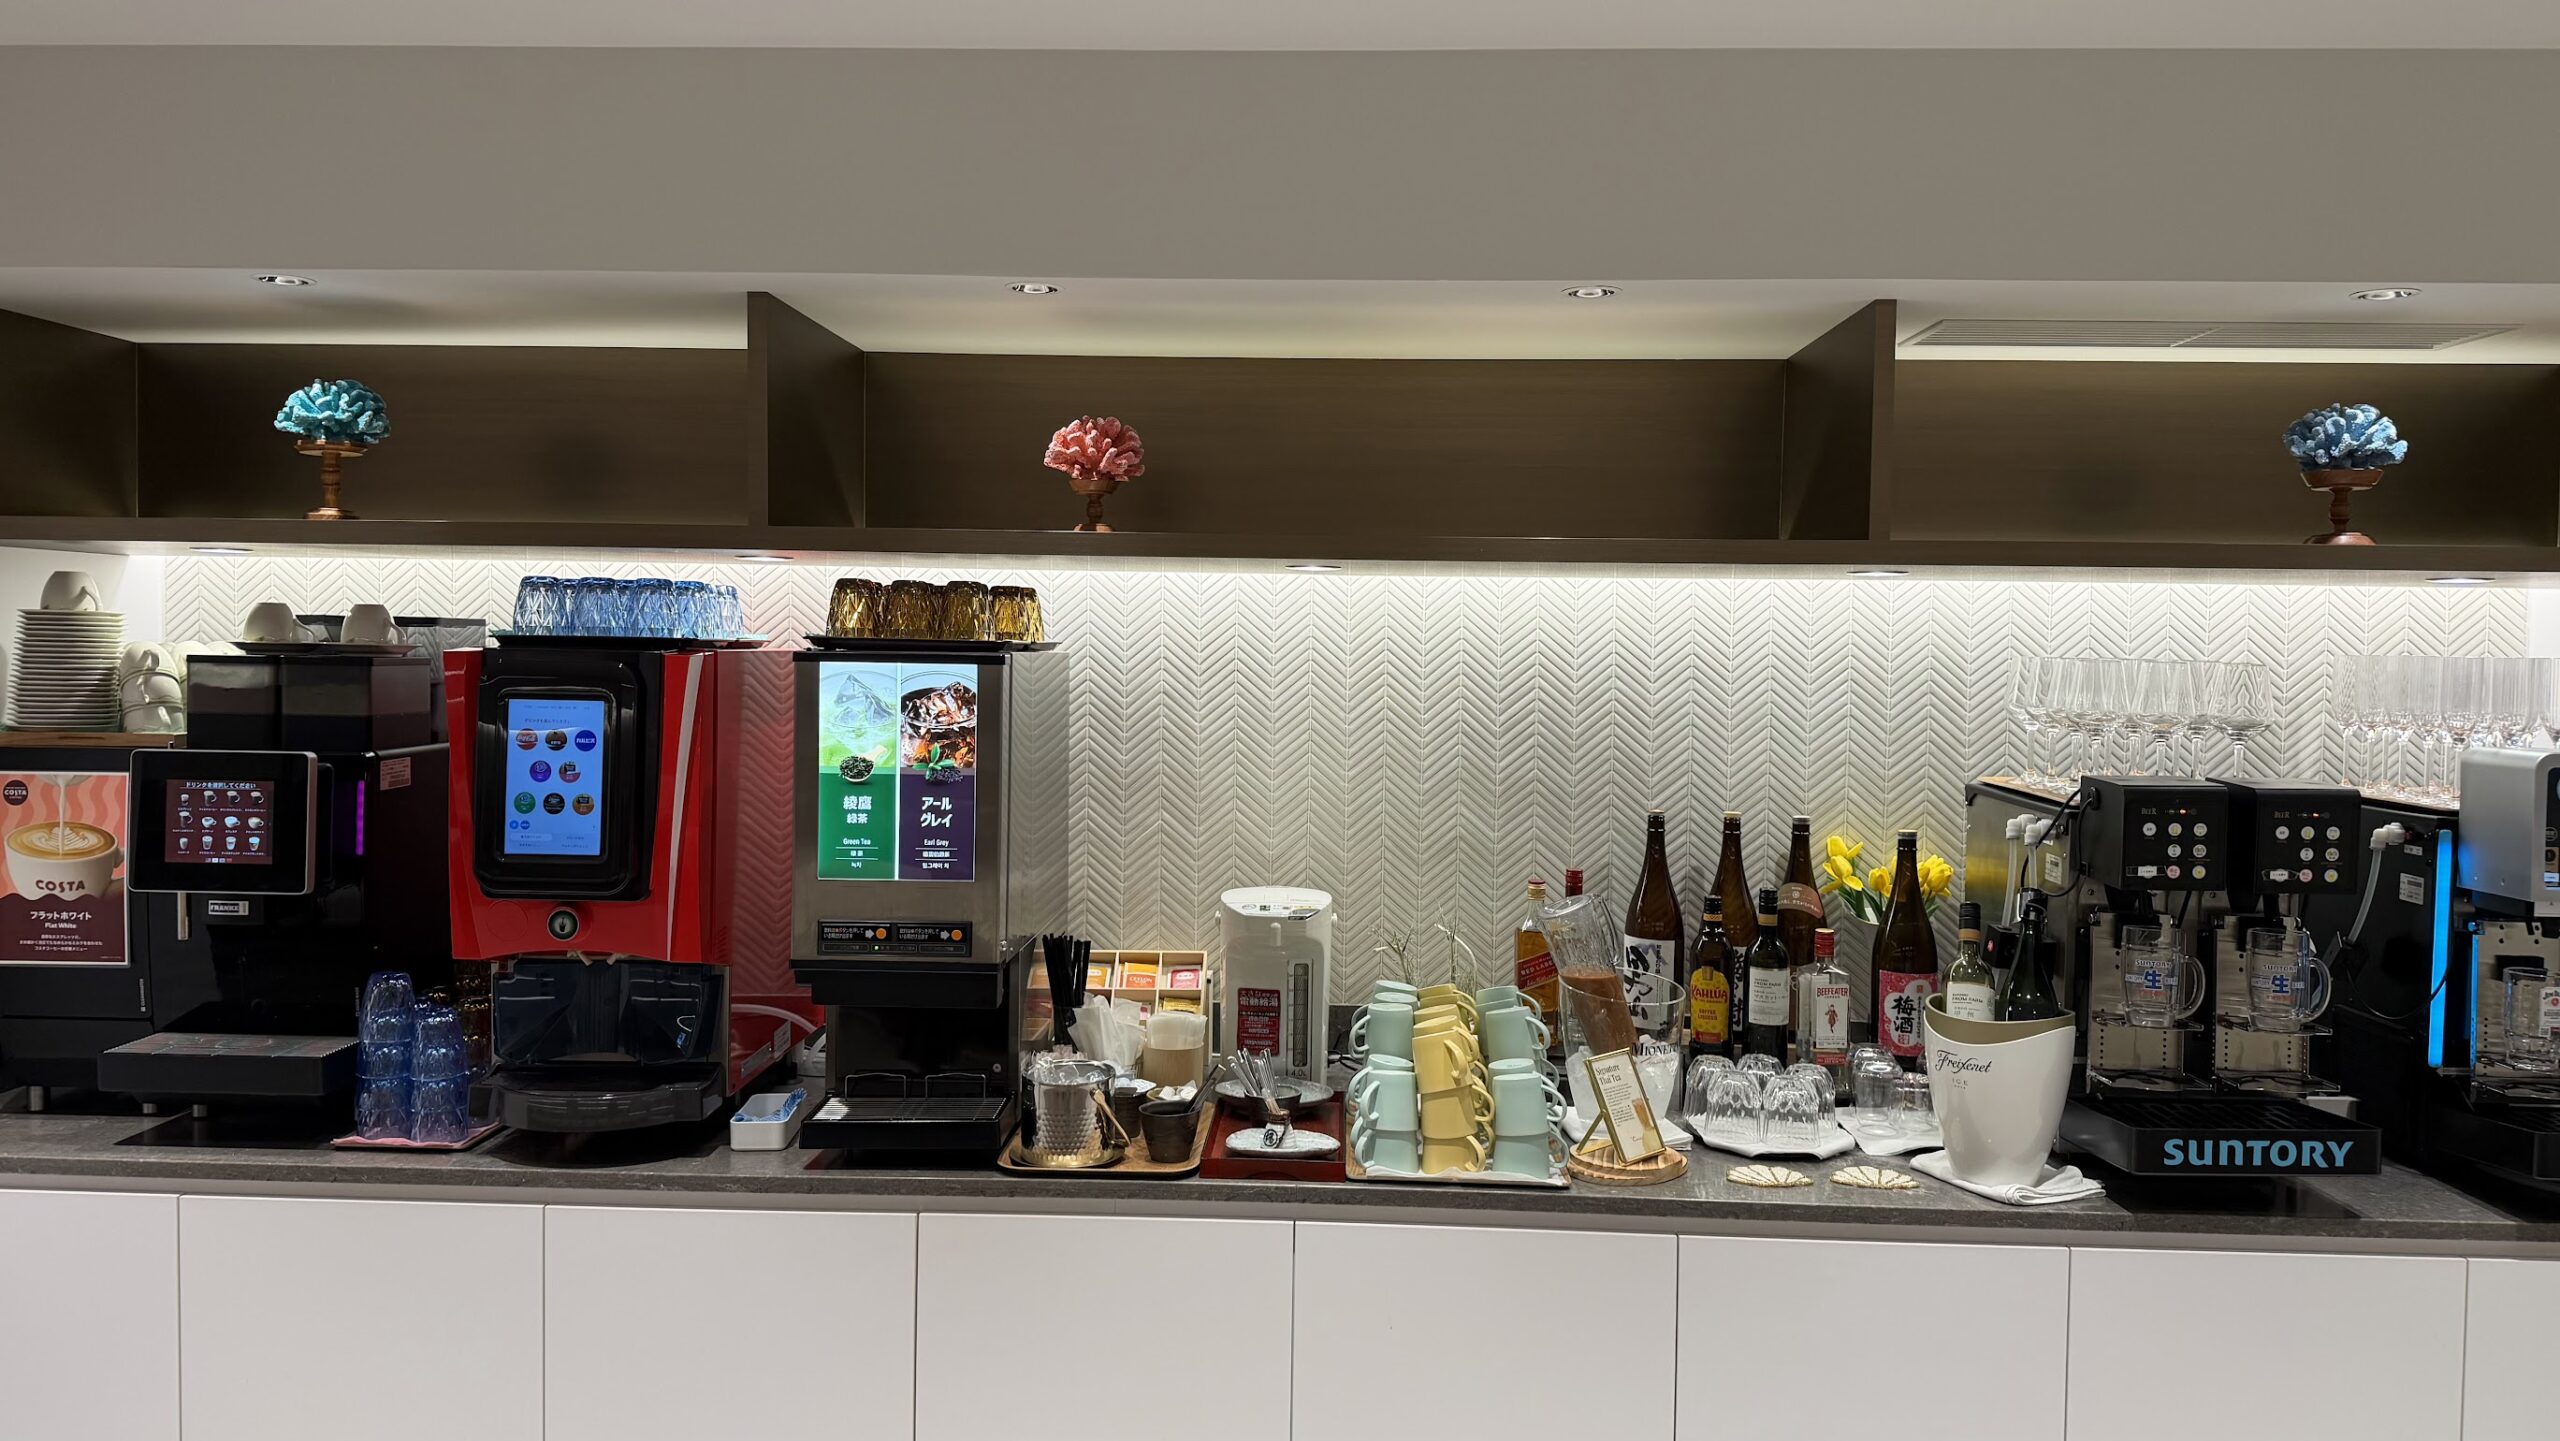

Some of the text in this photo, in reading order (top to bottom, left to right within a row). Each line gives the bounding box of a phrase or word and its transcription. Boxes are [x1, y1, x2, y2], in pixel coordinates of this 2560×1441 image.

[843, 795, 872, 810] 綾鷹
[921, 796, 952, 810] アール
[846, 813, 868, 824] 緑茶
[920, 813, 953, 828] グレイ
[936, 839, 949, 847] Grey
[35, 879, 86, 893] COSTA
[30, 911, 92, 920] フラットホワイト
[2144, 970, 2163, 990] 生
[2271, 974, 2290, 994] 生
[1691, 985, 1728, 1003] KAHLÚA
[1816, 987, 1849, 997] BEEFEATER
[1891, 995, 1917, 1034] 梅酒
[1935, 1050, 1992, 1074] Freixenet
[1595, 1065, 1620, 1076] Signature
[1599, 1074, 1622, 1085] Thai Tea
